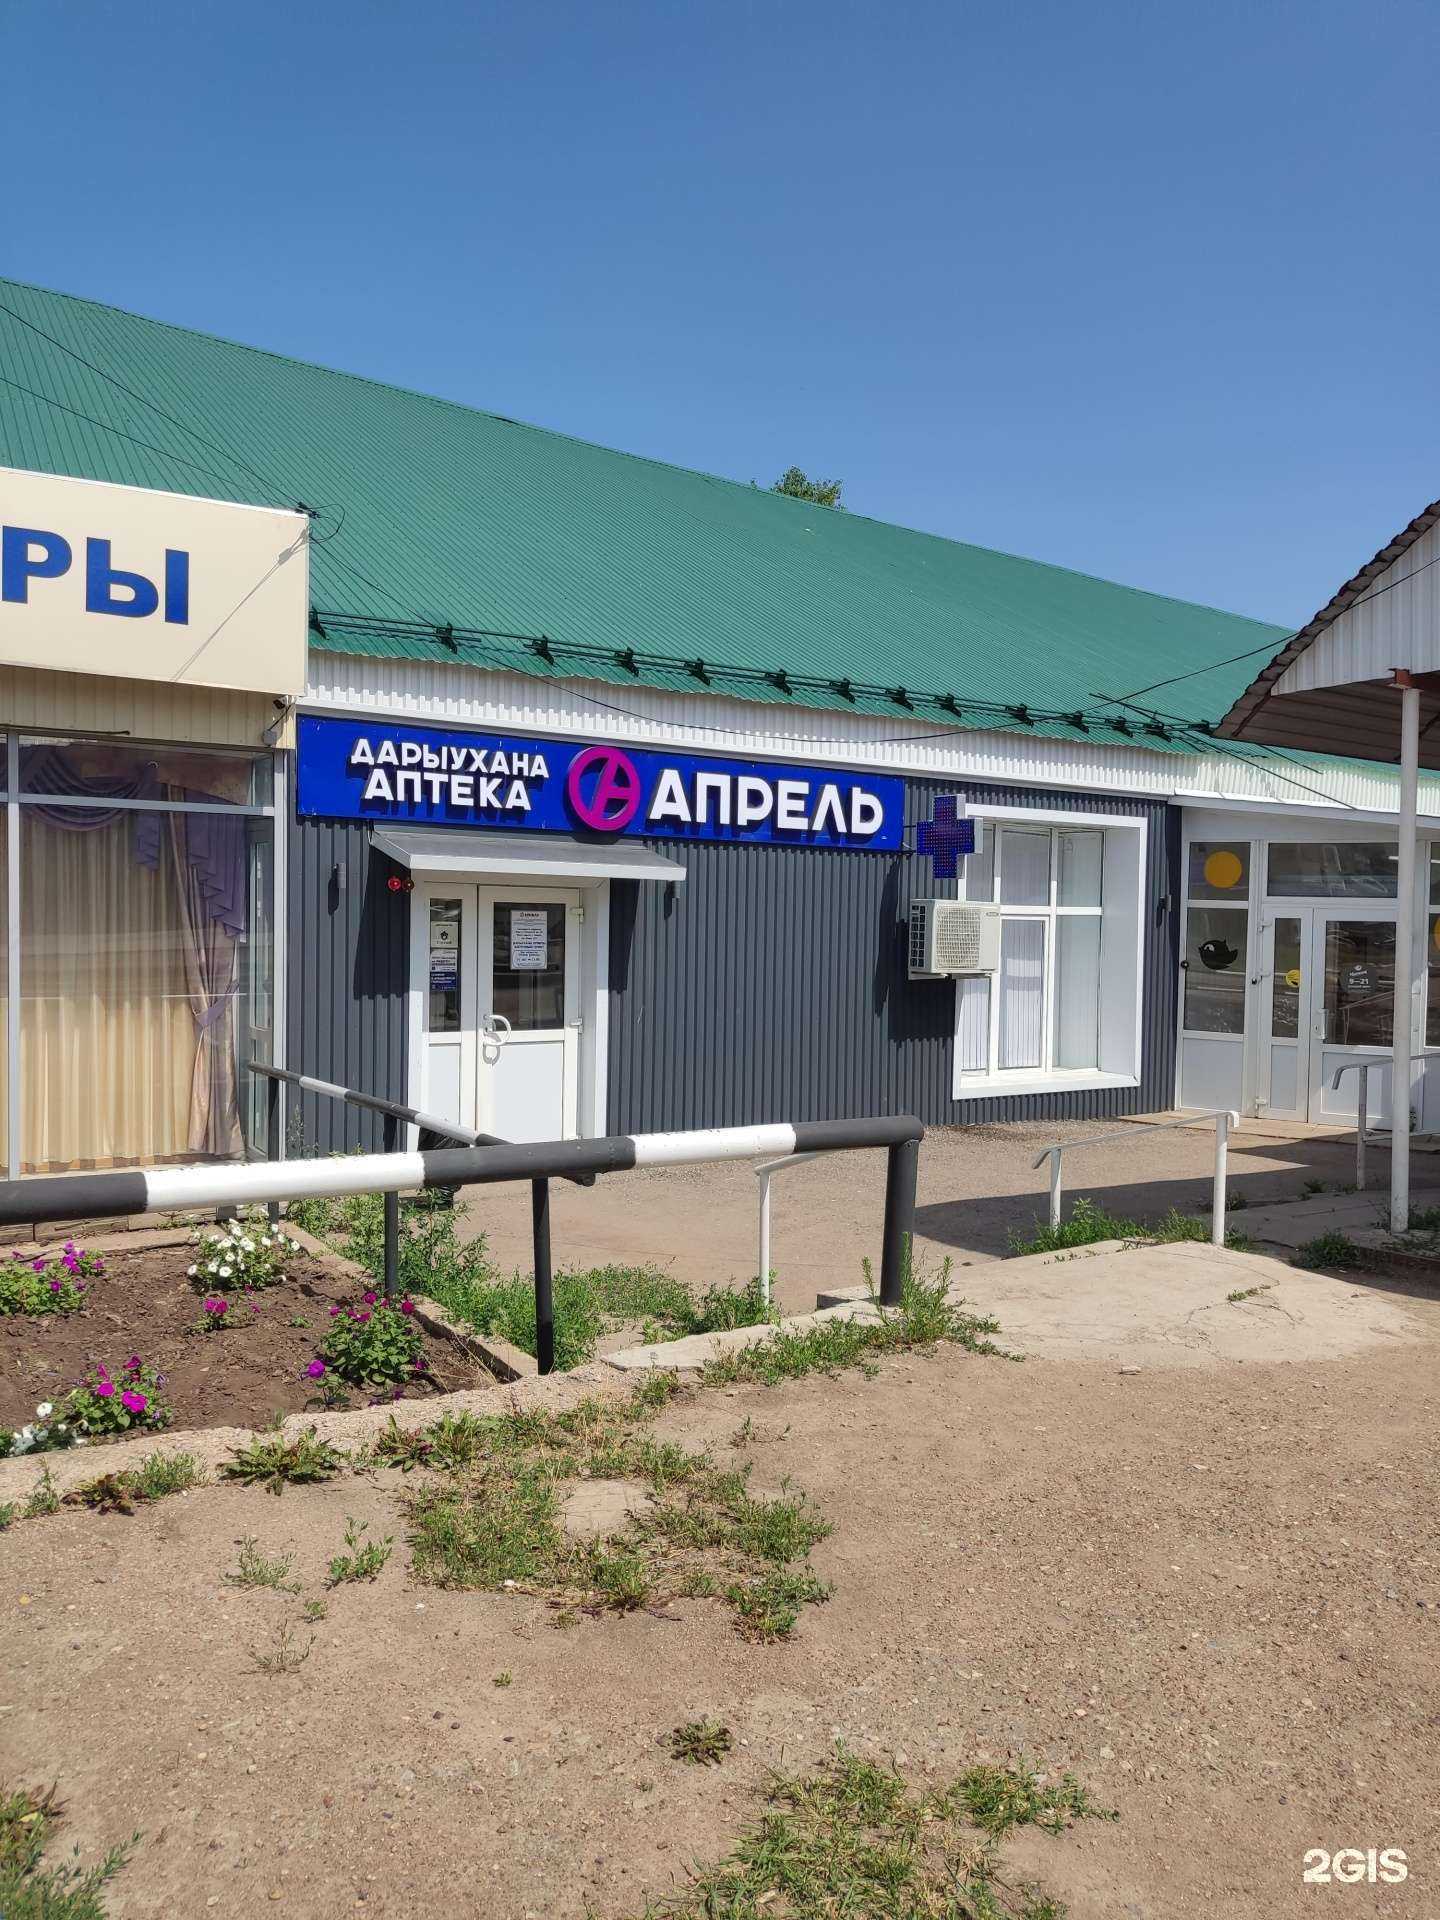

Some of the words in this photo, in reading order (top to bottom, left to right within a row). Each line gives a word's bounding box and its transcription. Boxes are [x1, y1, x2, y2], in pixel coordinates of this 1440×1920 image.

[2, 525, 190, 625] РЫ
[350, 738, 550, 779] ДАРЫУХАНА
[364, 768, 532, 811] АПТЕКА
[649, 768, 883, 835] АПРЕЛЬ
